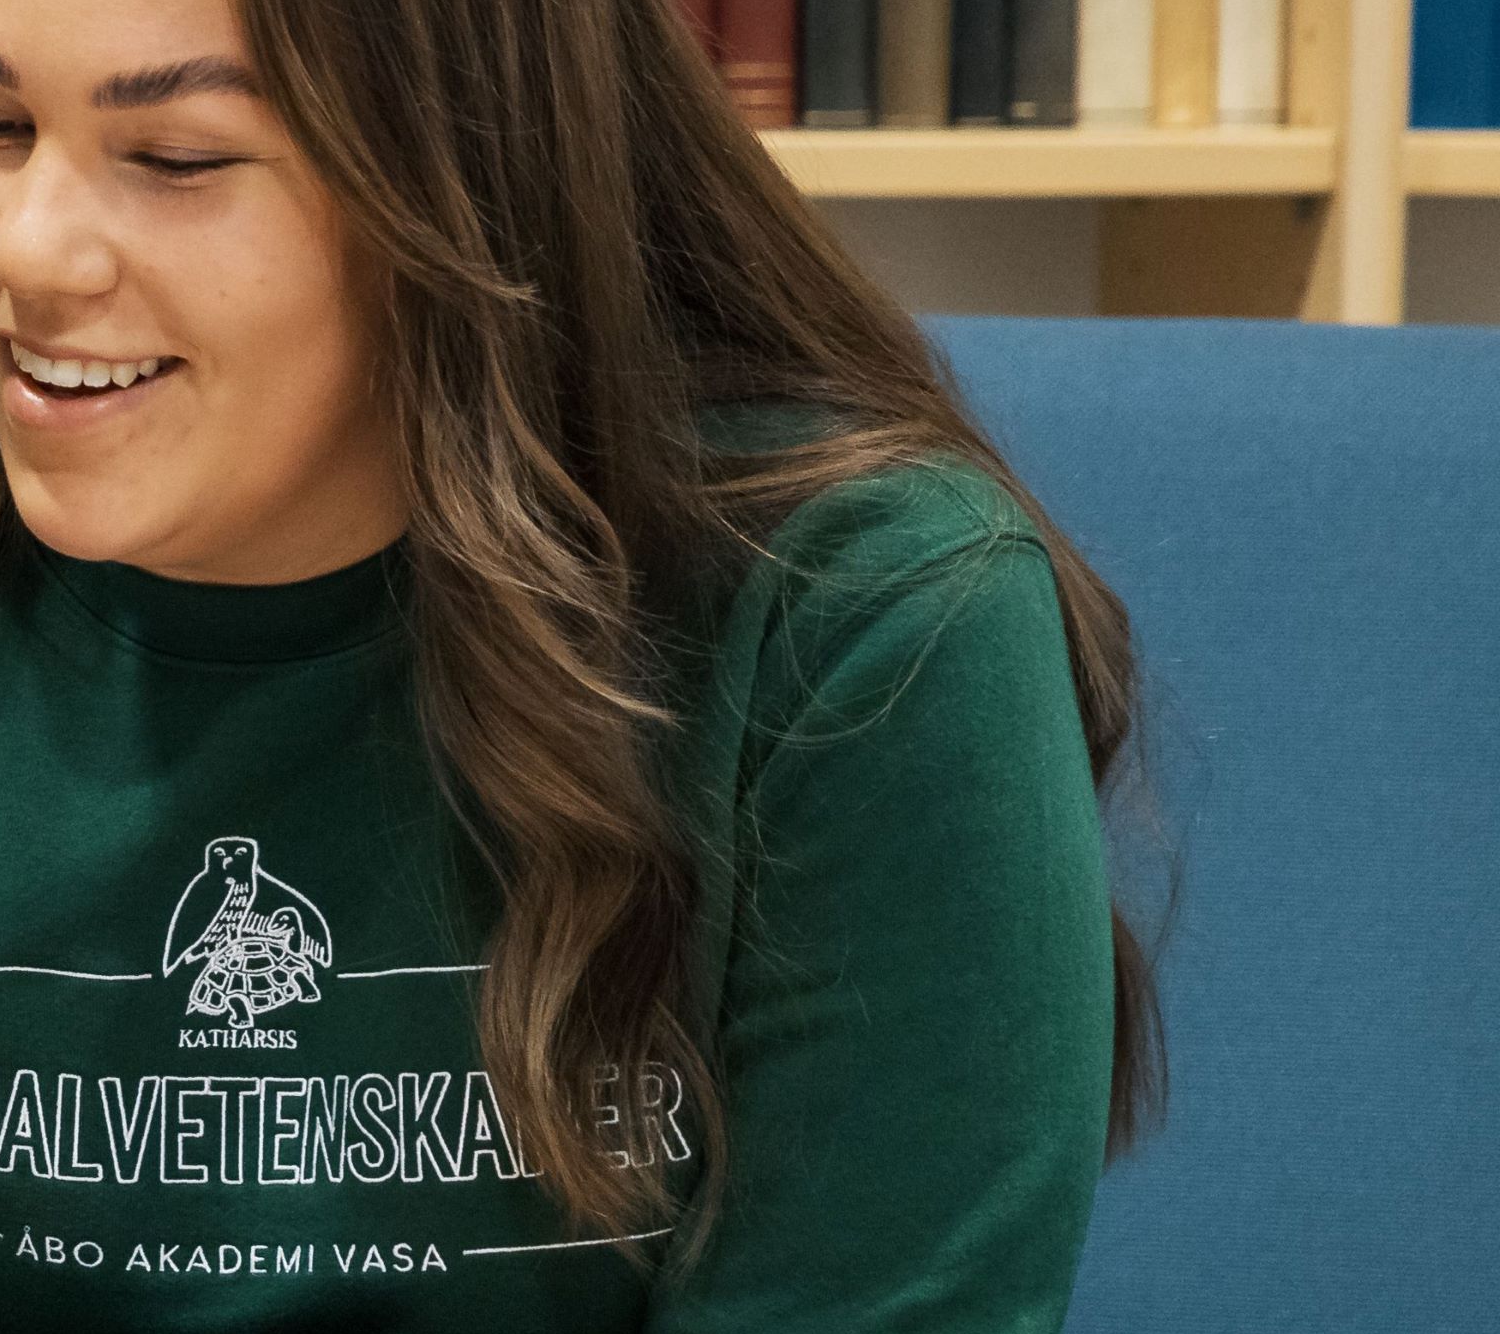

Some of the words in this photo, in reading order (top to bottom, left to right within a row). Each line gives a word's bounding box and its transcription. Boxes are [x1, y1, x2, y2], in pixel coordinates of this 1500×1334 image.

[178, 1028, 298, 1049] KATHARSIS
[16, 1226, 104, 1268] ÅBO
[126, 1243, 315, 1275] AKADEMI
[332, 1242, 448, 1274] VASA
